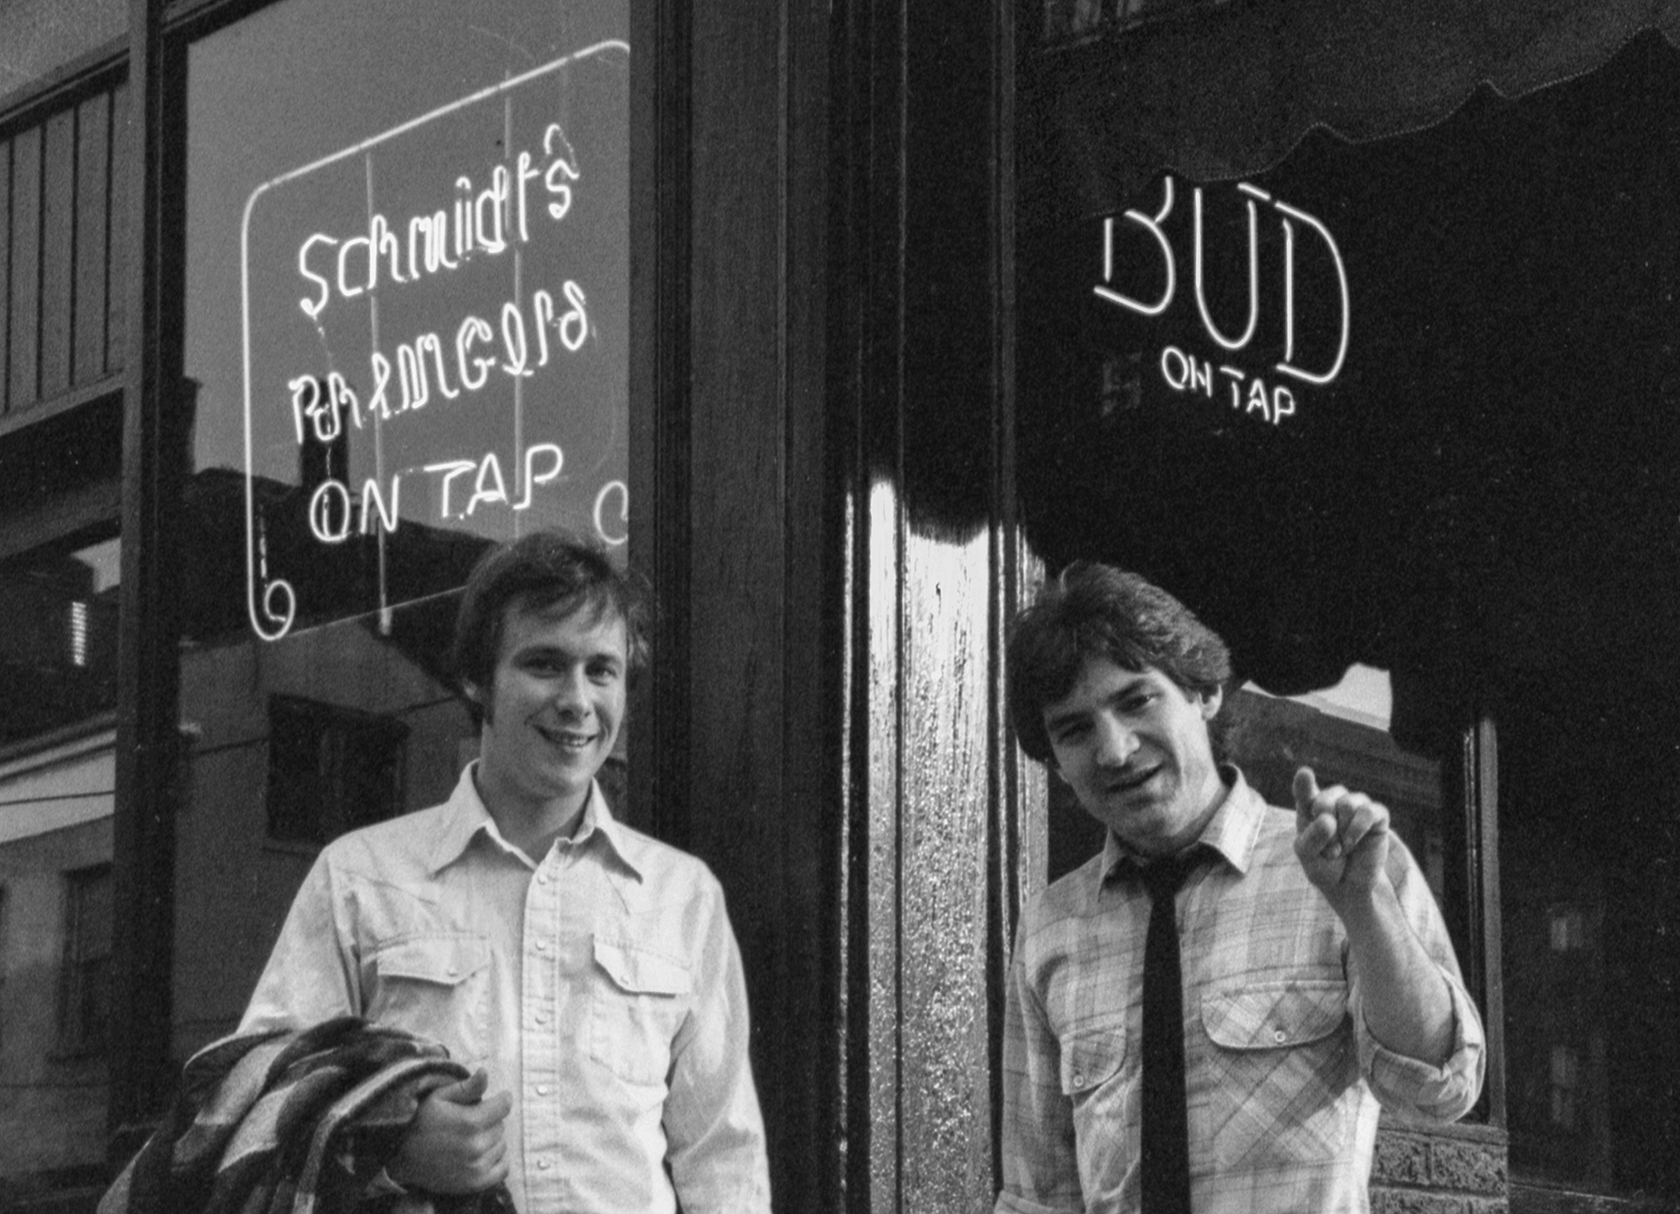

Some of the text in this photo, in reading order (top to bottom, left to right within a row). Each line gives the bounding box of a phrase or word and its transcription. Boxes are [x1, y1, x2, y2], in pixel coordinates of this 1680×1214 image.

[1093, 175, 1351, 384] BUD
[1160, 345, 1296, 426] ON TAP
[309, 444, 564, 543] ON TAP
